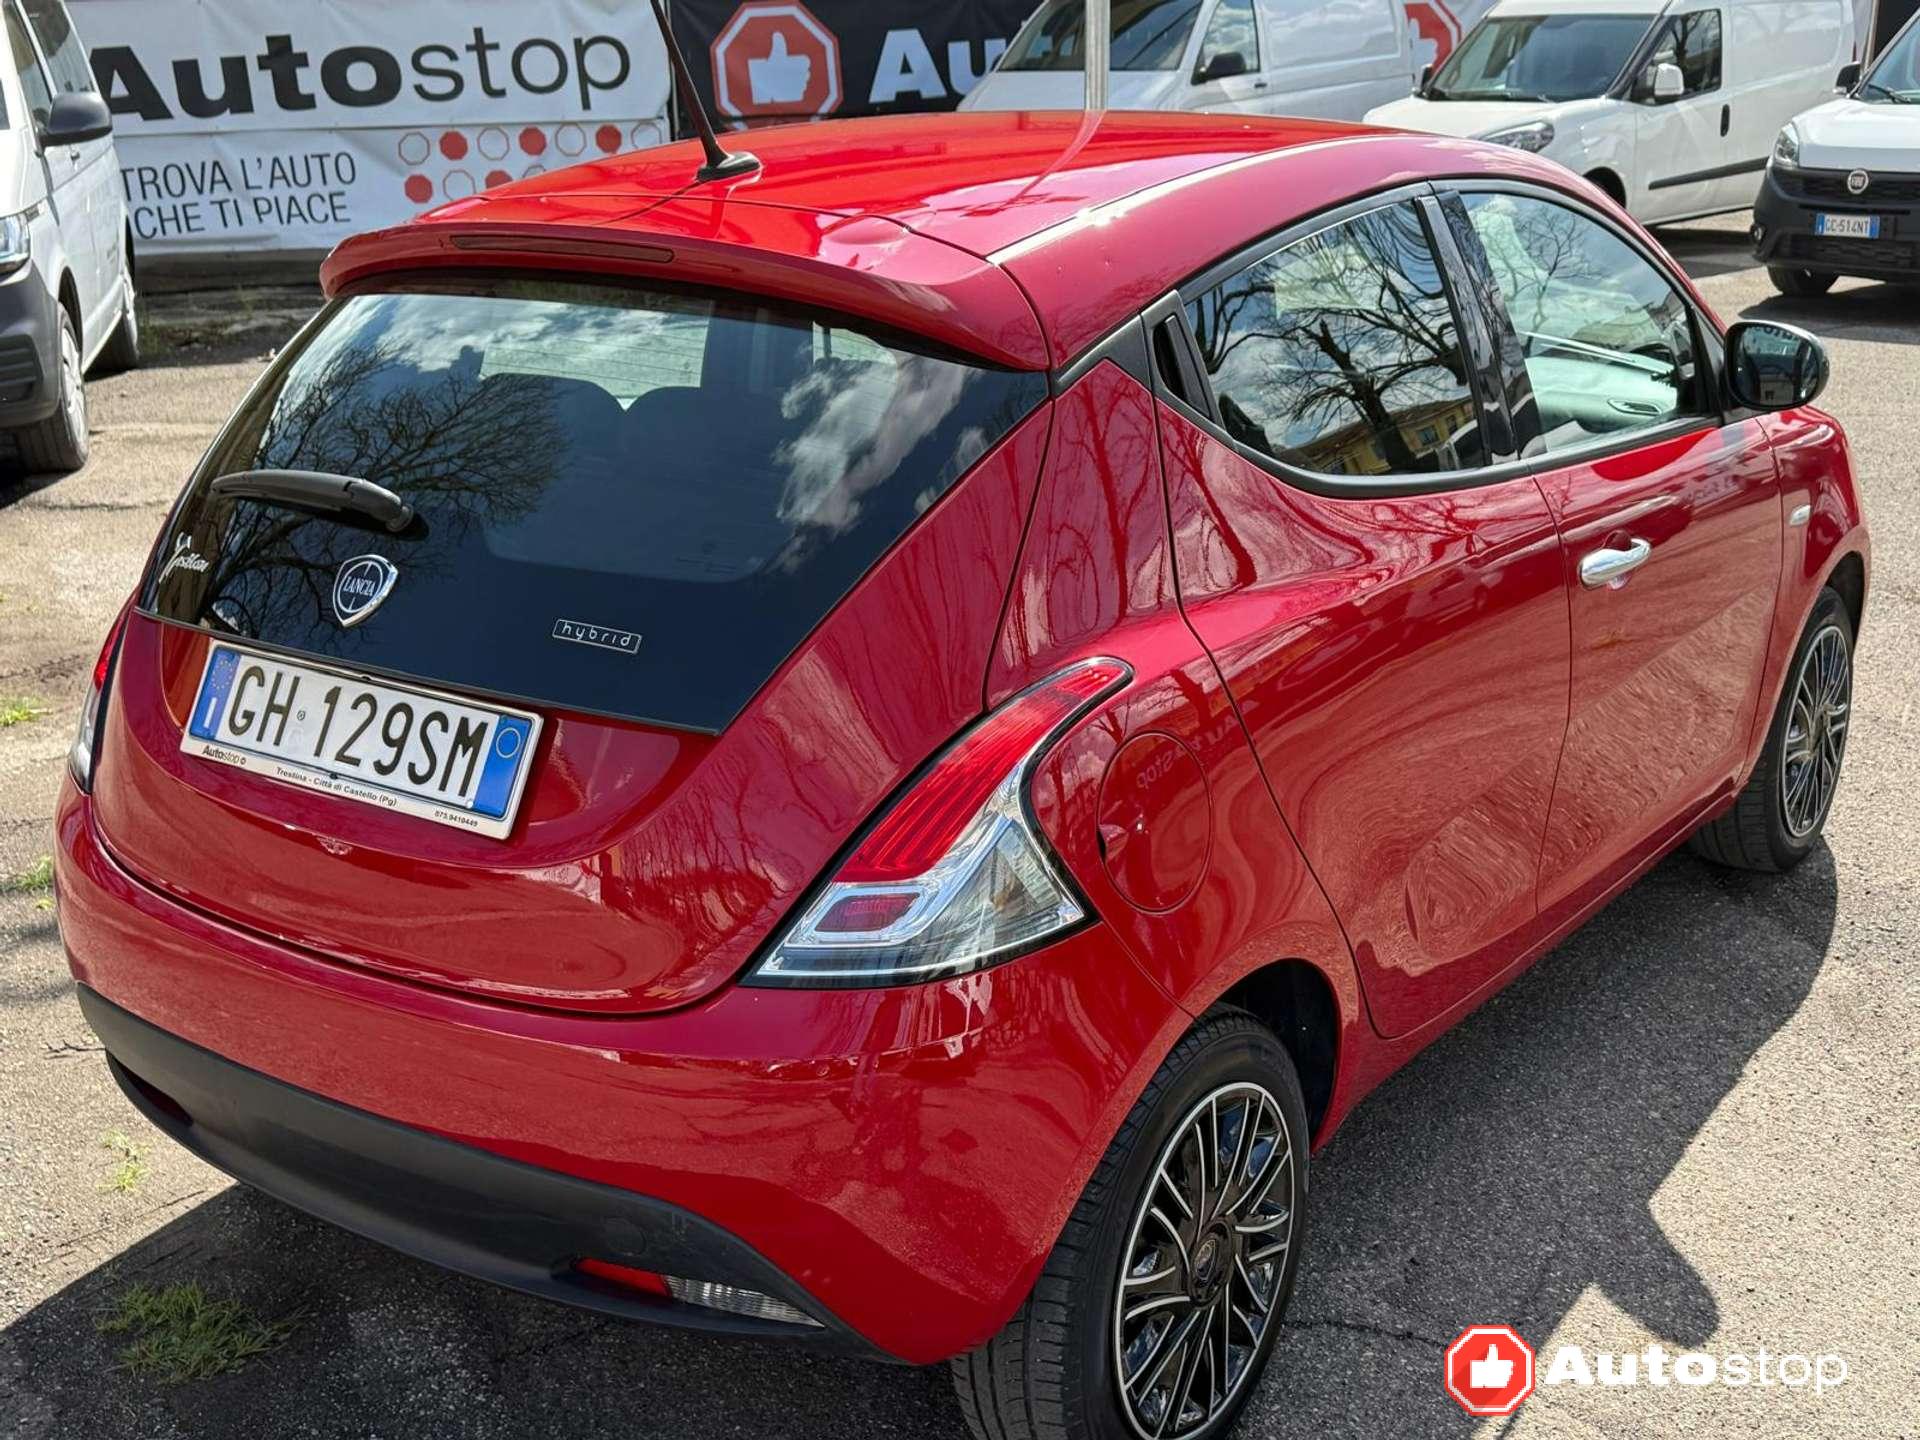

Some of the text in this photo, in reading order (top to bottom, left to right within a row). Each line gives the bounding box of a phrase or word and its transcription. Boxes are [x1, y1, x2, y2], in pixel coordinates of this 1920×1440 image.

[88, 27, 630, 121] Autostop
[869, 28, 1008, 103] Au
[120, 160, 232, 202] TROVA
[134, 191, 351, 239] CHE TI PIACE
[343, 576, 375, 596] LANCIA
[561, 622, 632, 646] hybrid
[343, 786, 377, 800] Castello
